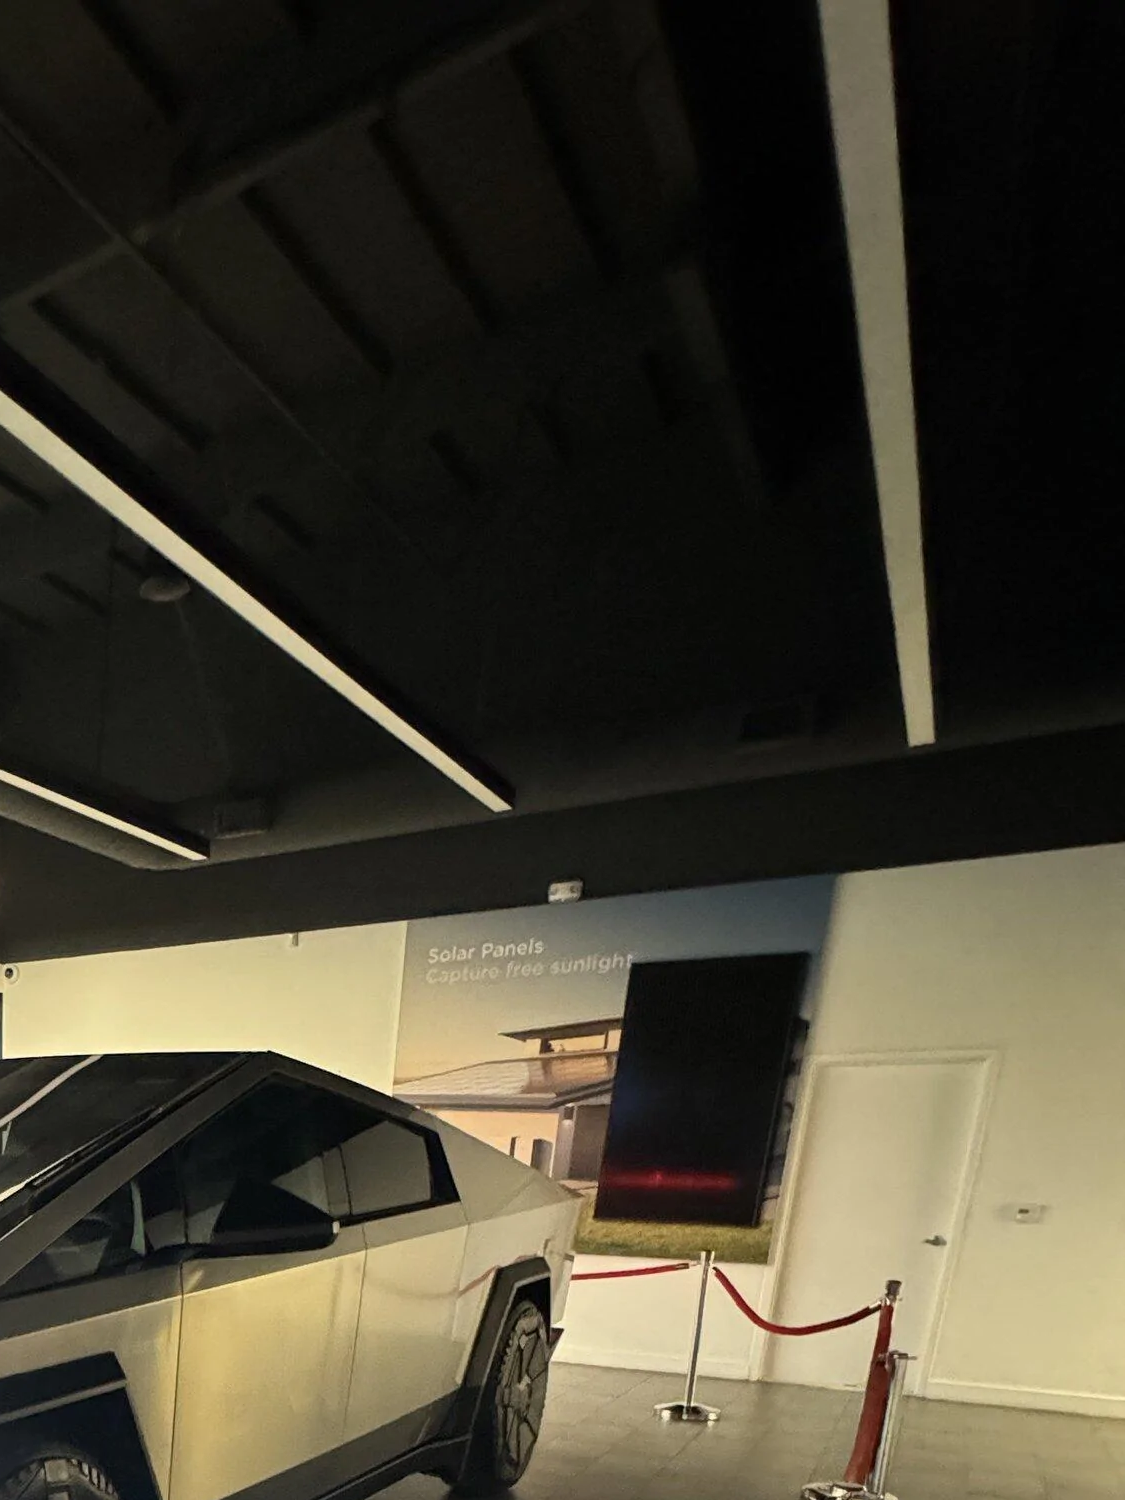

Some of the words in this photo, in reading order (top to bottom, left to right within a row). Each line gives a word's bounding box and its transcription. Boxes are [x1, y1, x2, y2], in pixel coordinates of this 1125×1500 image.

[427, 945, 476, 964] Solar
[480, 937, 545, 959] Panels
[425, 965, 500, 985] Capture
[505, 960, 546, 979] free
[549, 953, 633, 975] sunlight
